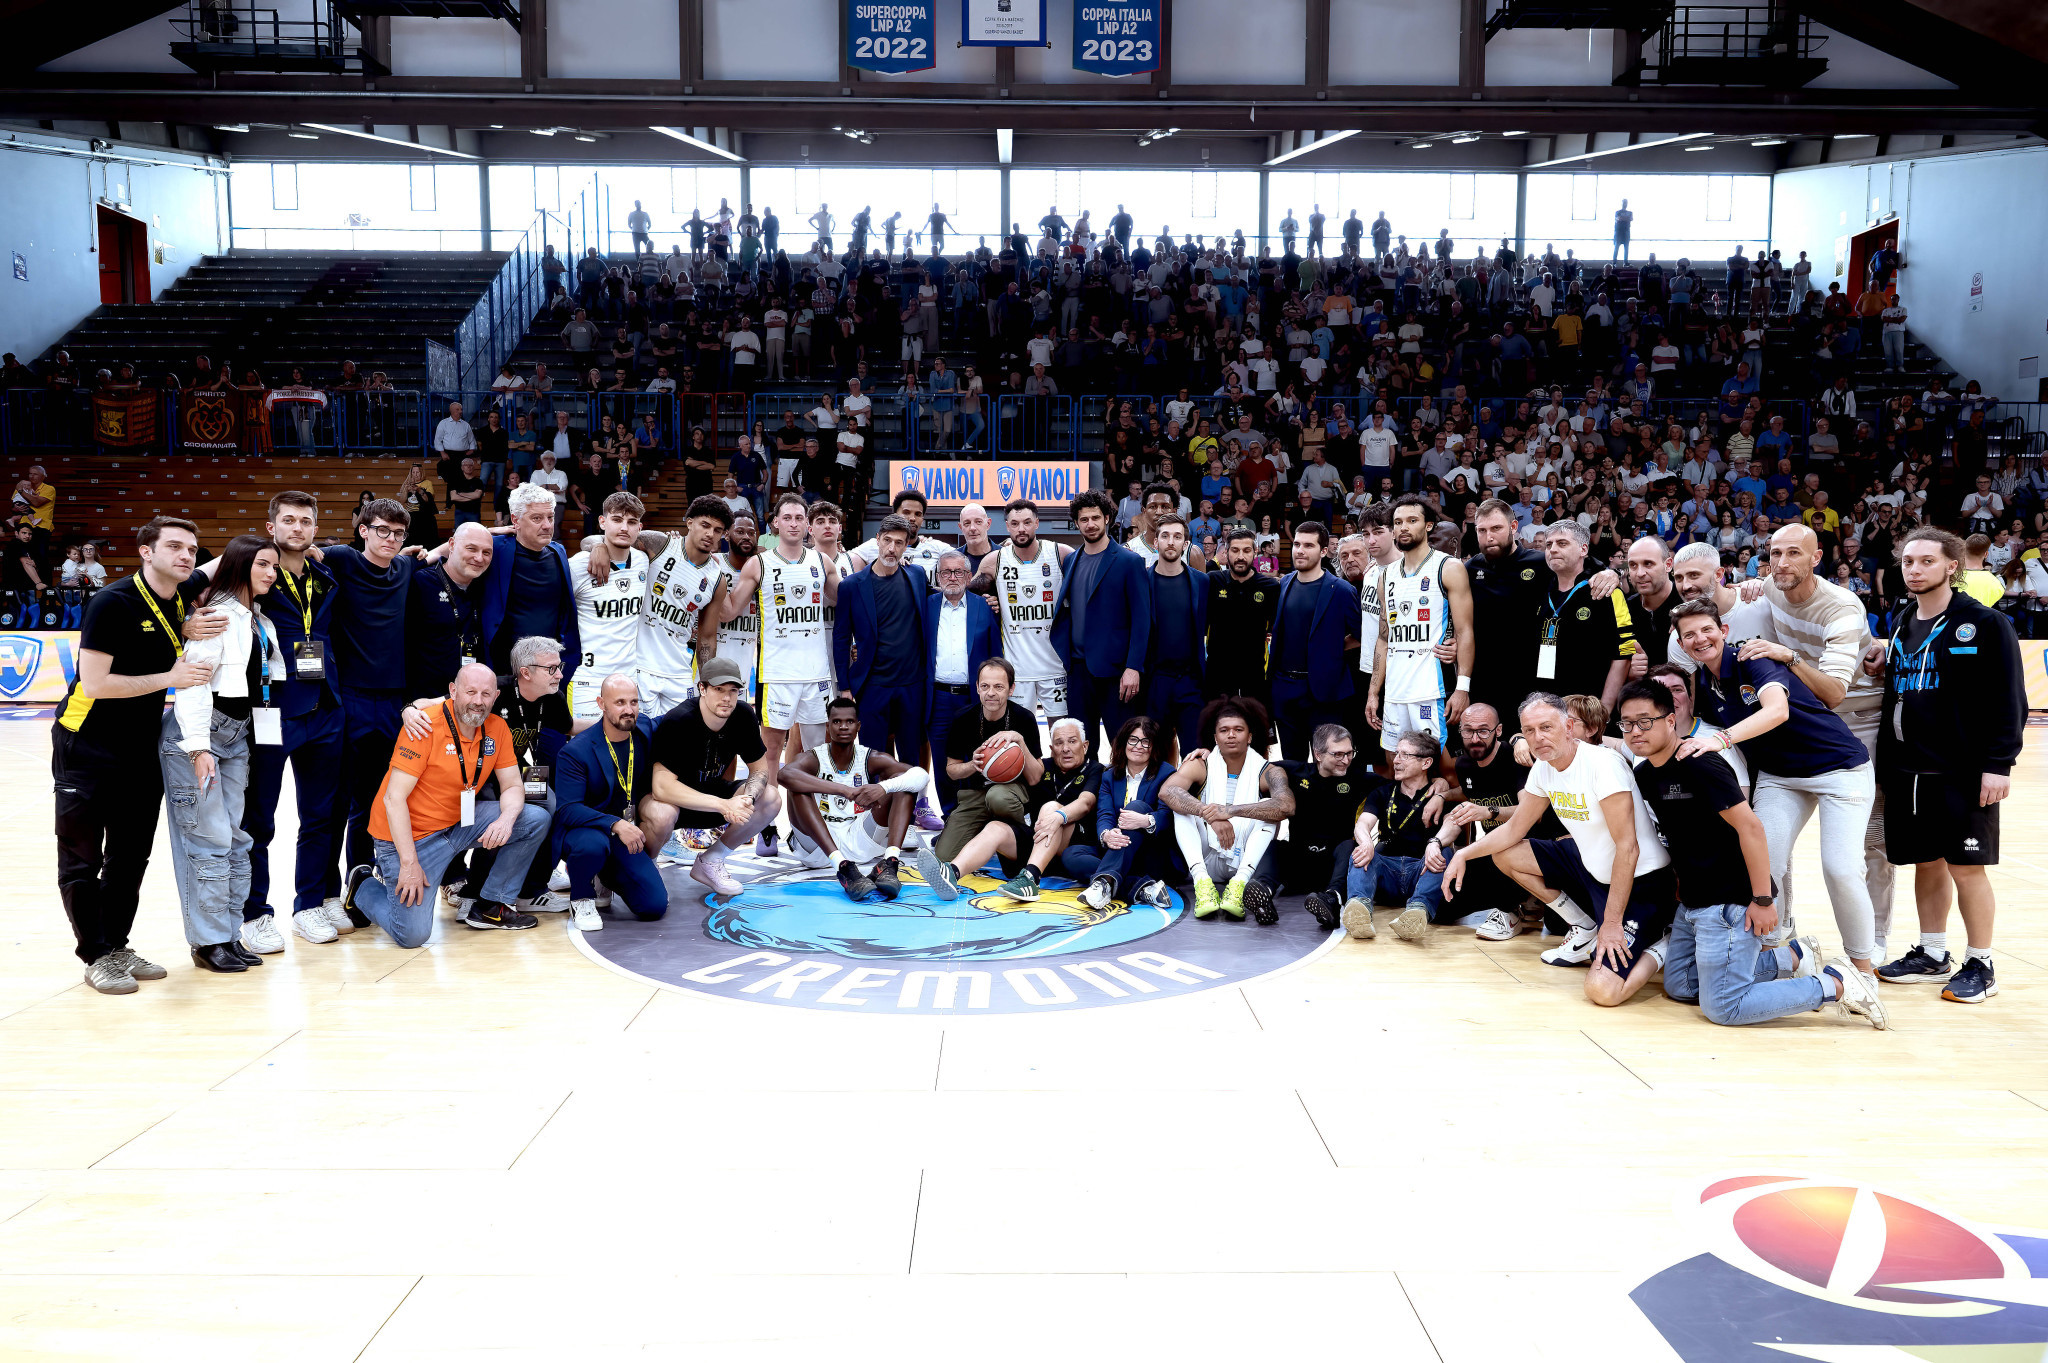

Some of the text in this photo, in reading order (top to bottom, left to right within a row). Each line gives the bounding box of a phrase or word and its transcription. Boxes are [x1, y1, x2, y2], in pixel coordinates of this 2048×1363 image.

[856, 5, 927, 19] SUPERCOPPA
[1082, 8, 1152, 21] COPPA ITALIA
[871, 19, 911, 32] LNP A2
[1097, 21, 1137, 35] LNP A2
[856, 36, 927, 59] 2022
[1082, 39, 1153, 61] 2023
[922, 467, 984, 500] VANOLI
[1018, 467, 1080, 501] VANOLI
[663, 557, 676, 572] 8
[773, 568, 781, 582] 7
[1003, 566, 1019, 580] 23
[1388, 582, 1395, 597] 2
[681, 951, 1227, 1009] CREMONA
